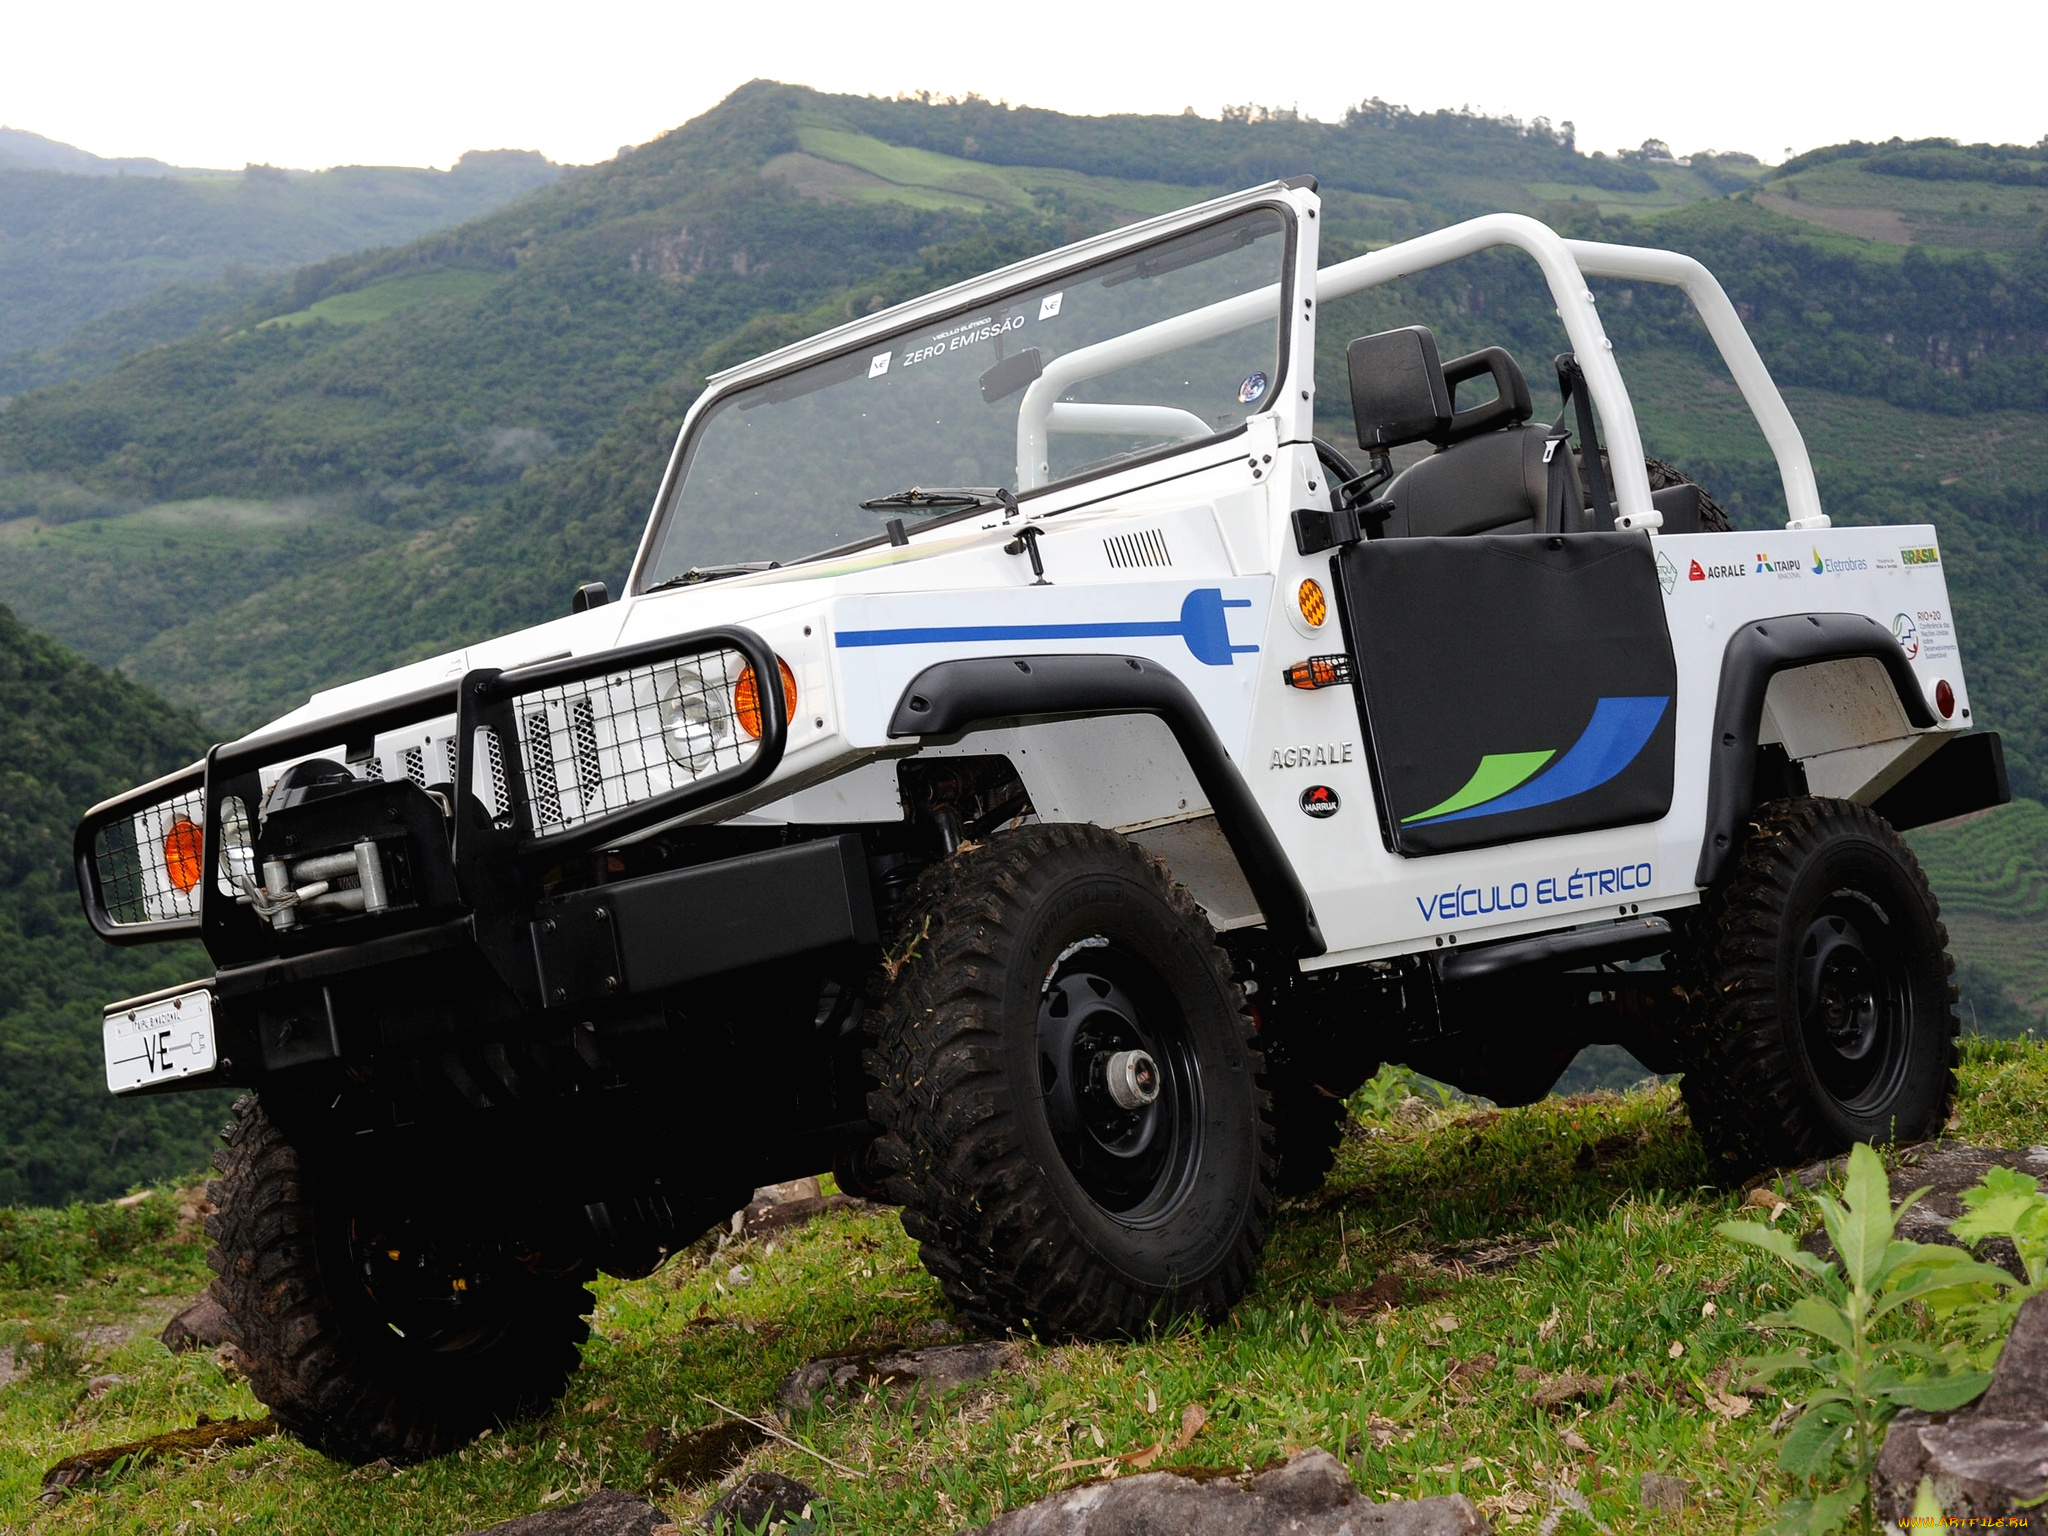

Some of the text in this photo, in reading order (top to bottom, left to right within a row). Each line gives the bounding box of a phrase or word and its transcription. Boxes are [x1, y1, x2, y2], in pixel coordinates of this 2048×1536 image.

[903, 315, 1026, 367] ZERO EMISSÃO
[1824, 557, 1868, 573] Eletrobras
[1901, 547, 1939, 565] BRASIL
[1707, 564, 1746, 579] AGRALE
[1773, 559, 1801, 572] ITAIPU
[1917, 611, 1941, 621] RIO+20
[1269, 741, 1353, 771] AGRALE
[1416, 862, 1652, 922] VEÍCULO ELÉTRICO
[143, 1030, 174, 1074] VE
